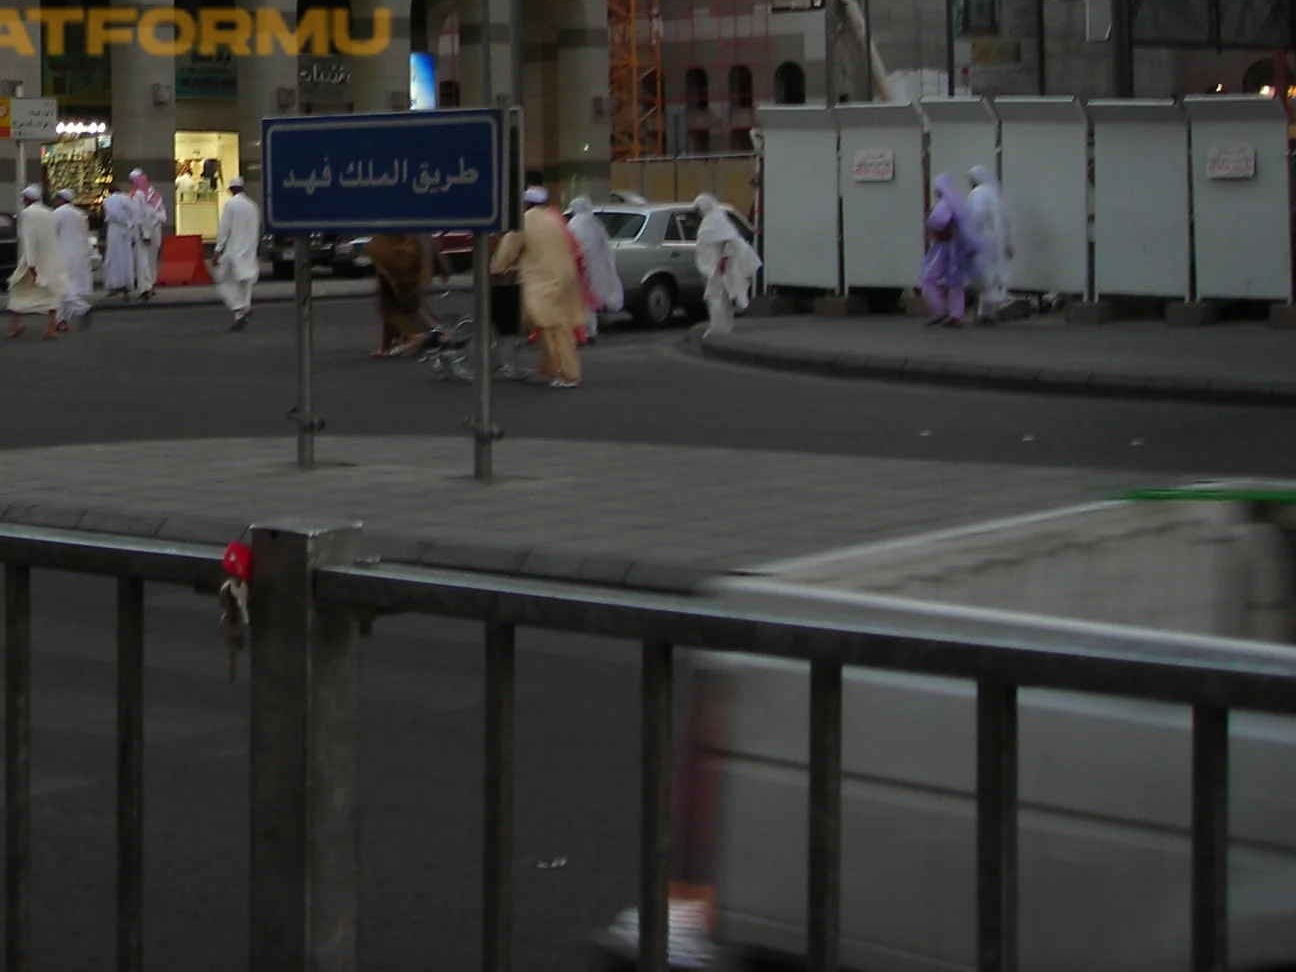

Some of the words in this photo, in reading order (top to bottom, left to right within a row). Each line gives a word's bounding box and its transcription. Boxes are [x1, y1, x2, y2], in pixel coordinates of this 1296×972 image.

[282, 155, 333, 196] فهد
[339, 157, 408, 189] الملك
[412, 156, 480, 195] طريق
